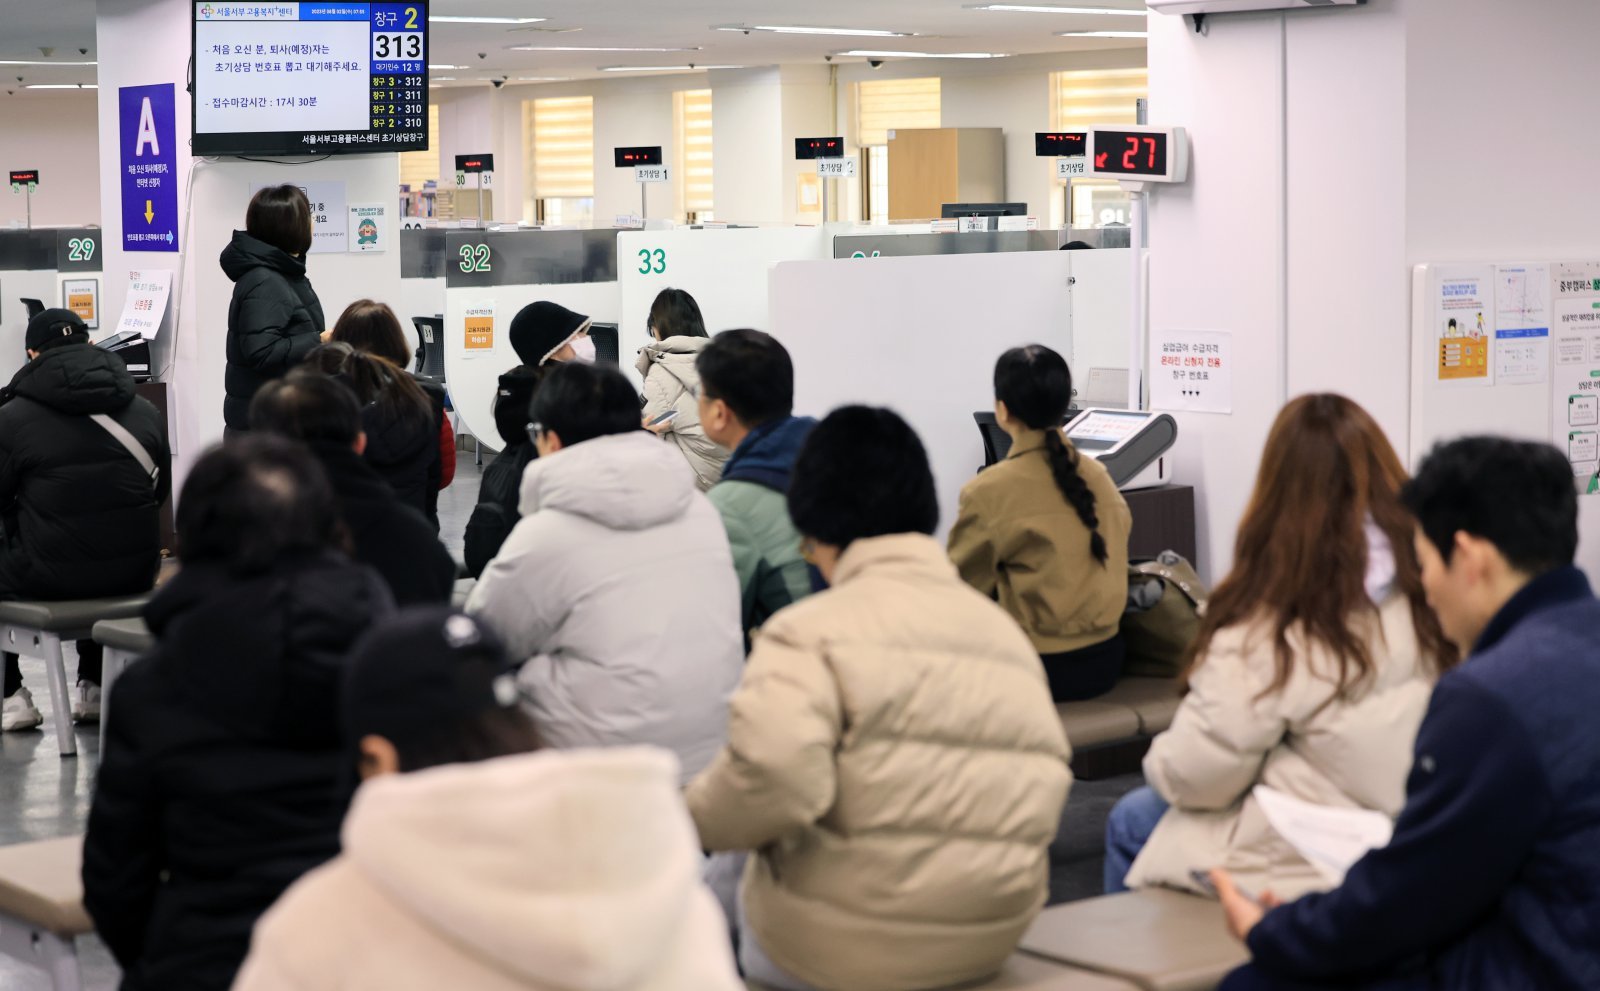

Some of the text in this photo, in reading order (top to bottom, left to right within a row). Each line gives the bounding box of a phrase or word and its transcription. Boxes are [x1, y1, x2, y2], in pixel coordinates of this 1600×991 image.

[217, 8, 245, 16] 서울서부
[375, 8, 418, 28] 창구 2
[212, 45, 230, 54] 처음
[235, 45, 251, 54] 오신
[256, 45, 266, 55] 분,
[270, 45, 330, 55] 퇴사(예정)자는
[376, 35, 421, 58] 313
[216, 62, 361, 72] 초기상담 번호표 뽑고 대기해주세요.
[403, 63, 412, 71] 12
[373, 78, 421, 86] 창구 3 312
[373, 91, 421, 100] 창구 1 311
[212, 98, 266, 108] 접수마감시간
[276, 98, 294, 107] 17시
[298, 98, 317, 107] 30분
[373, 105, 421, 114] 창구 2 310
[136, 96, 160, 156] A
[373, 119, 421, 127] 창구 2 310
[302, 133, 423, 144] 서울서부고용플러스센터 초기상담창구
[1123, 137, 1155, 169] 27
[821, 163, 842, 172] 초기상담
[1060, 163, 1084, 173] 초기상담
[638, 170, 667, 179] 초기상담 1
[457, 175, 491, 185] 30 31
[318, 203, 324, 211] 중
[69, 238, 94, 261] 29
[459, 244, 491, 272] 32
[638, 248, 666, 274] 33
[1560, 280, 1592, 292] 중부캠퍼스
[1163, 343, 1218, 353] 실업급여 수급자격
[1161, 356, 1221, 368] 온라인 신청자 전용
[1173, 370, 1208, 380] 창구 번호표
